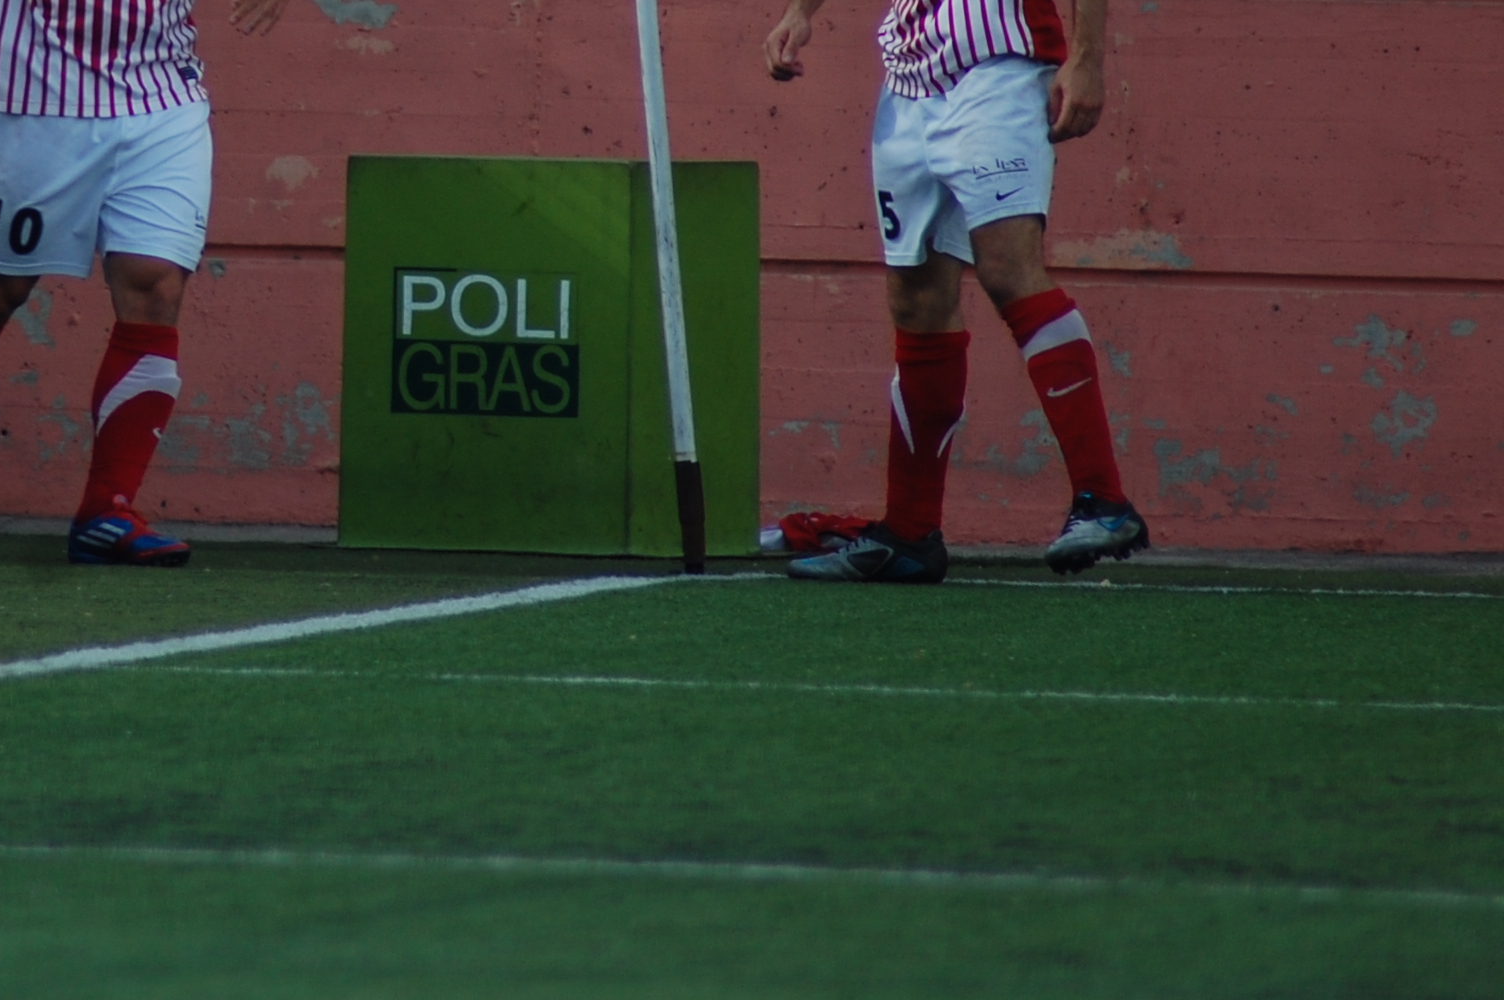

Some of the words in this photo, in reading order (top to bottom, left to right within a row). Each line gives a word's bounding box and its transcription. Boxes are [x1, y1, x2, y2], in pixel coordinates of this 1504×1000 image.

[878, 189, 901, 241] 5
[401, 274, 572, 339] POLI
[398, 342, 571, 415] GRAS
